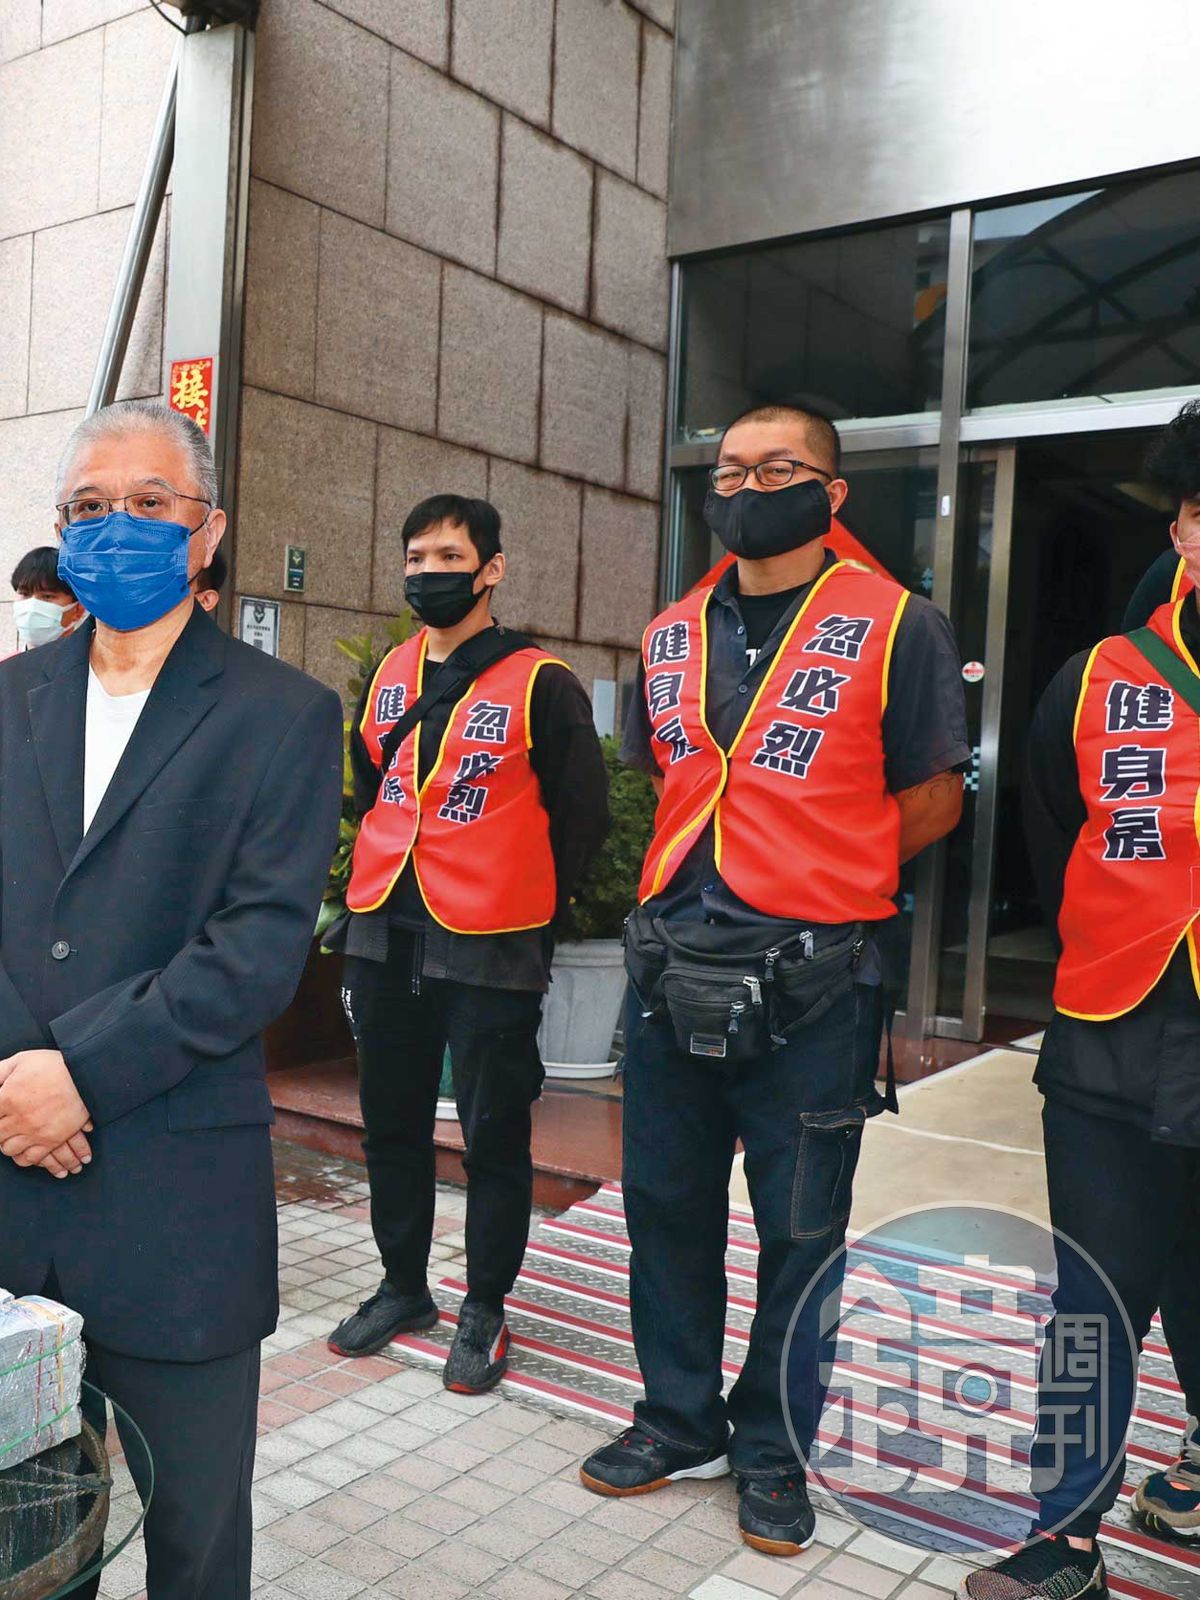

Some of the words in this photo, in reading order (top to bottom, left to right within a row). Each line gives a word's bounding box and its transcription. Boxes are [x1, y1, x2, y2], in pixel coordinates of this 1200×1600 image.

[172, 369, 209, 428] 接
[437, 700, 513, 825] 忽必烈
[751, 613, 874, 780] 忽必烈
[1100, 680, 1174, 860] 健身房
